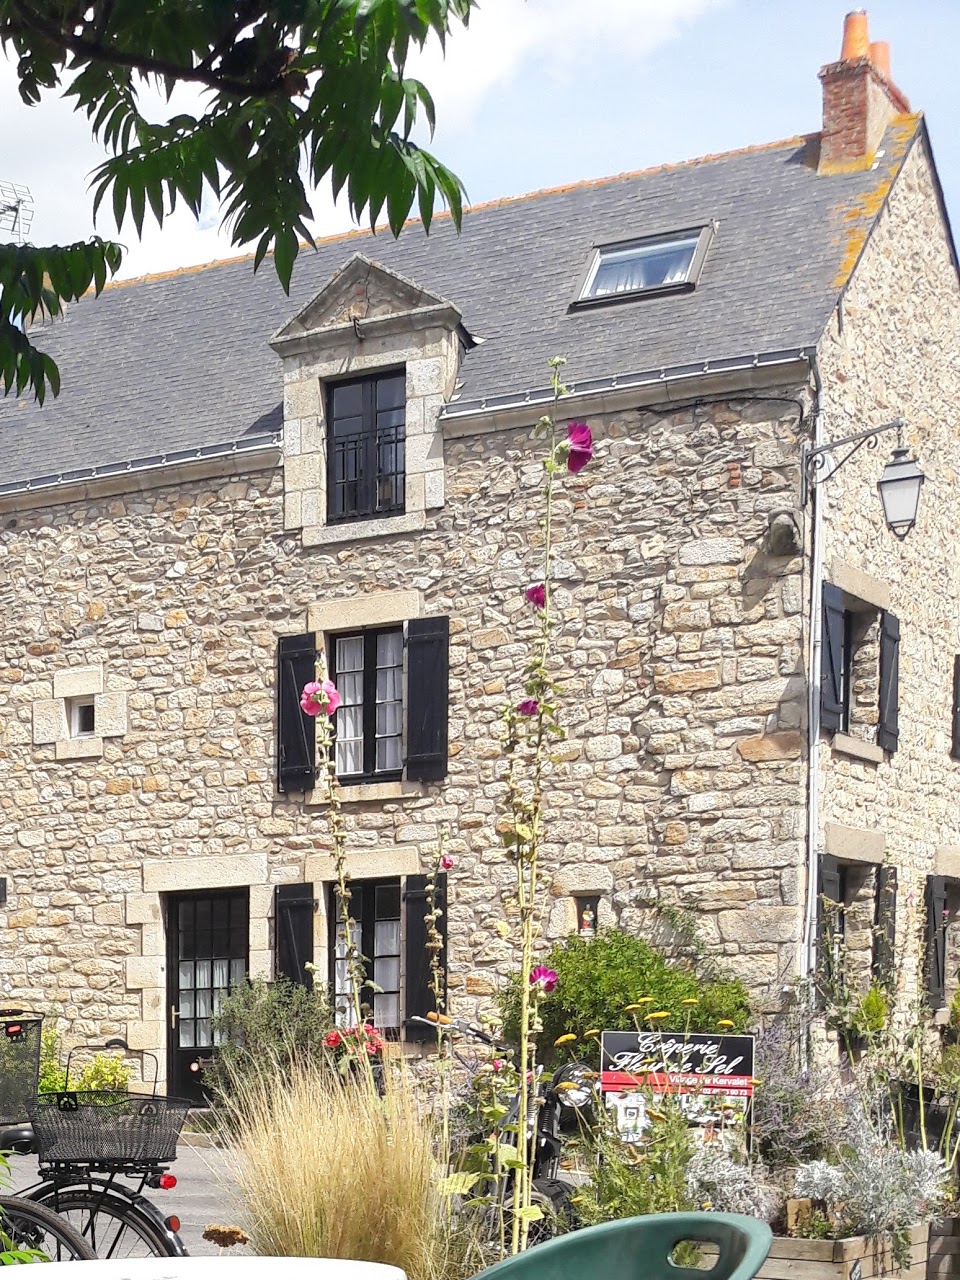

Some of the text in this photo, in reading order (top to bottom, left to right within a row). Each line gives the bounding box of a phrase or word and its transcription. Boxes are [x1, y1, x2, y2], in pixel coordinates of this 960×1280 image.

[638, 1033, 719, 1058] Crêperie
[695, 1055, 744, 1075] Sel
[712, 1077, 748, 1087] Kervalet
